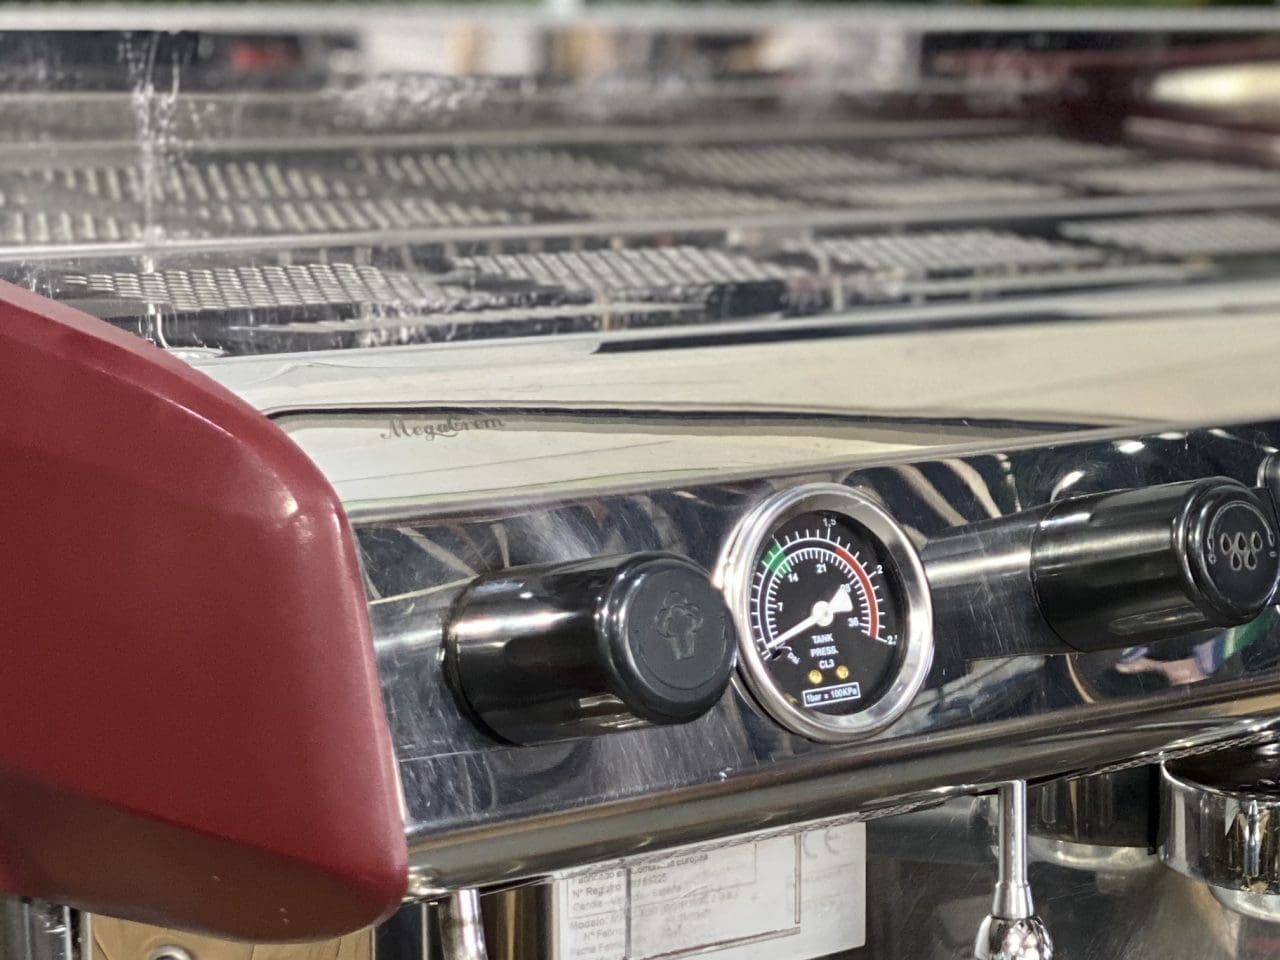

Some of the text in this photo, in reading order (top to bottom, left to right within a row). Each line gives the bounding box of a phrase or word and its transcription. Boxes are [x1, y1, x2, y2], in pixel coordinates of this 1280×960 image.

[816, 563, 827, 574] 21
[876, 565, 884, 574] 2
[787, 573, 799, 583] 14
[811, 633, 834, 645] TANK
[809, 645, 839, 658] PRESS.
[818, 659, 835, 669] CL3
